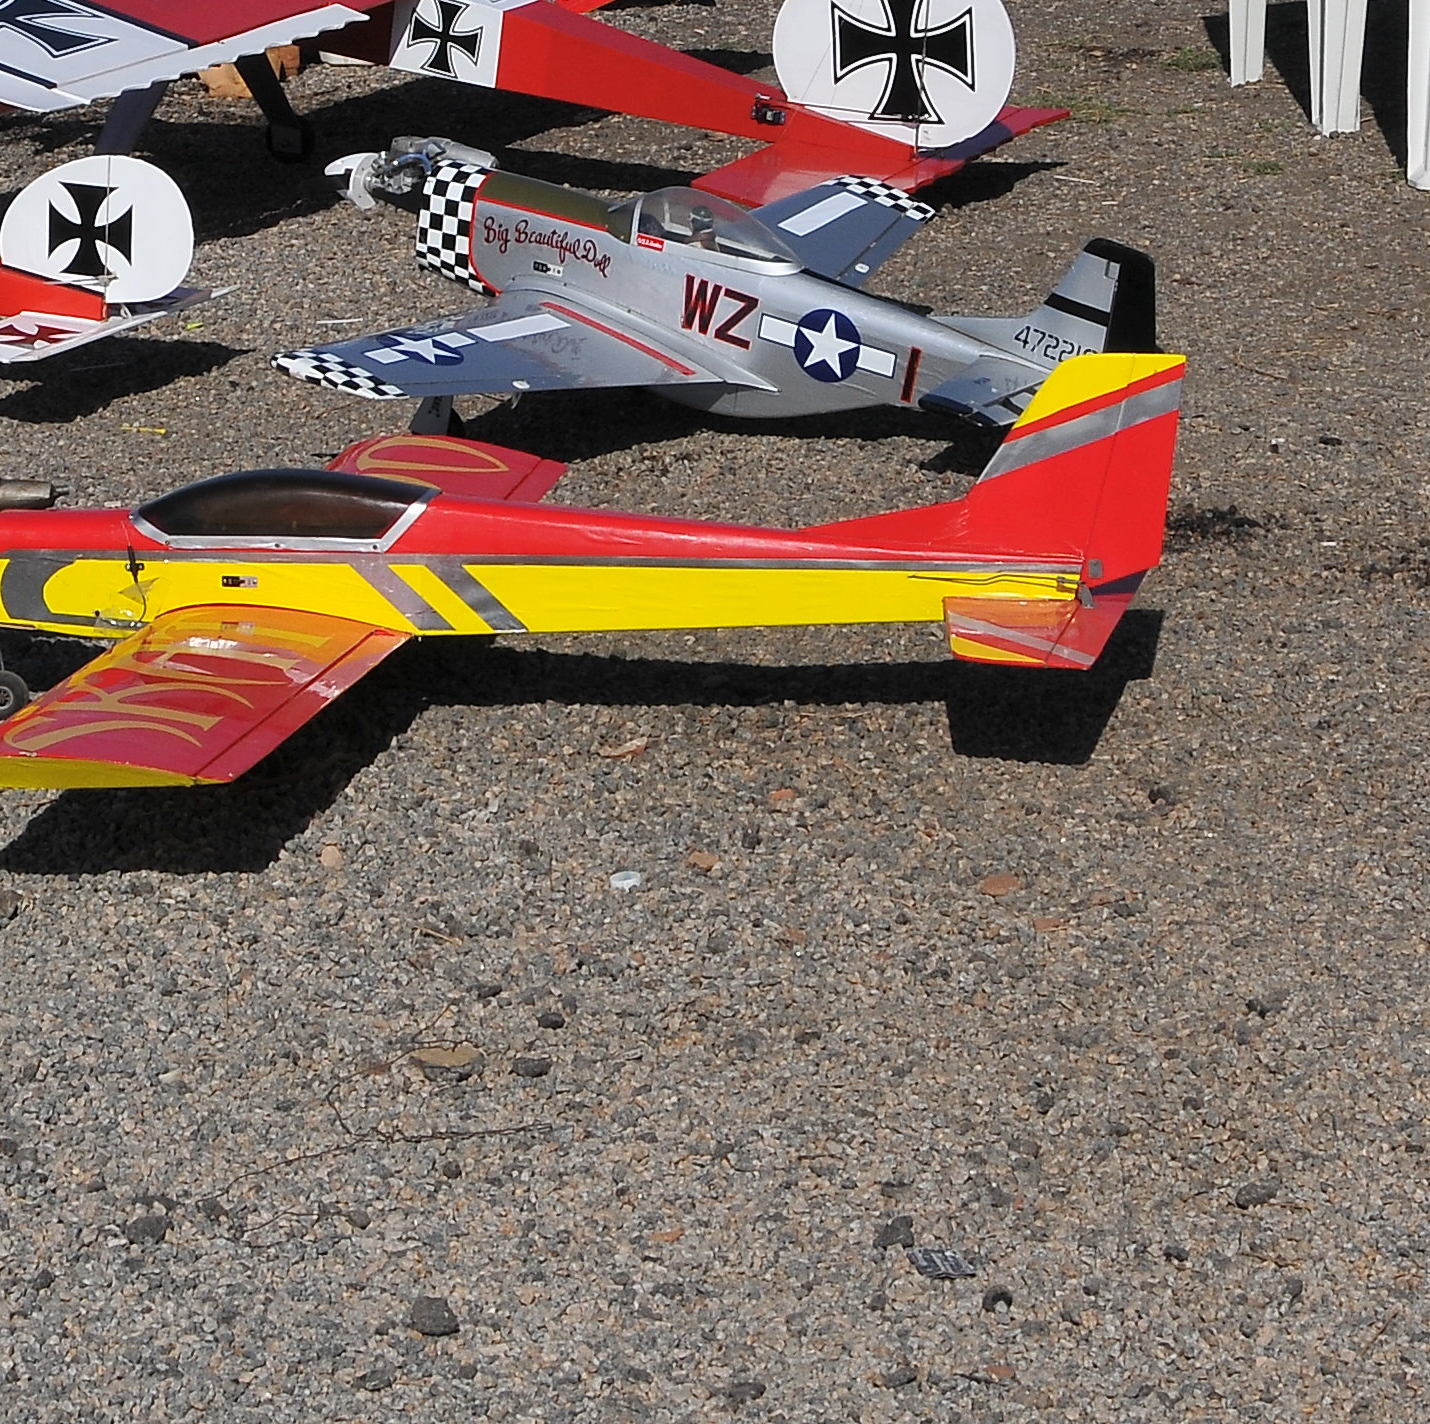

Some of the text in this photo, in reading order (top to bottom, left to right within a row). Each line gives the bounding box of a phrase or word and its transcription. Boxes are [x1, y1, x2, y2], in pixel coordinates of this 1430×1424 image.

[483, 215, 512, 255] Big
[514, 218, 581, 265] Beautiful
[581, 239, 612, 279] Doll
[681, 273, 762, 352] WZ
